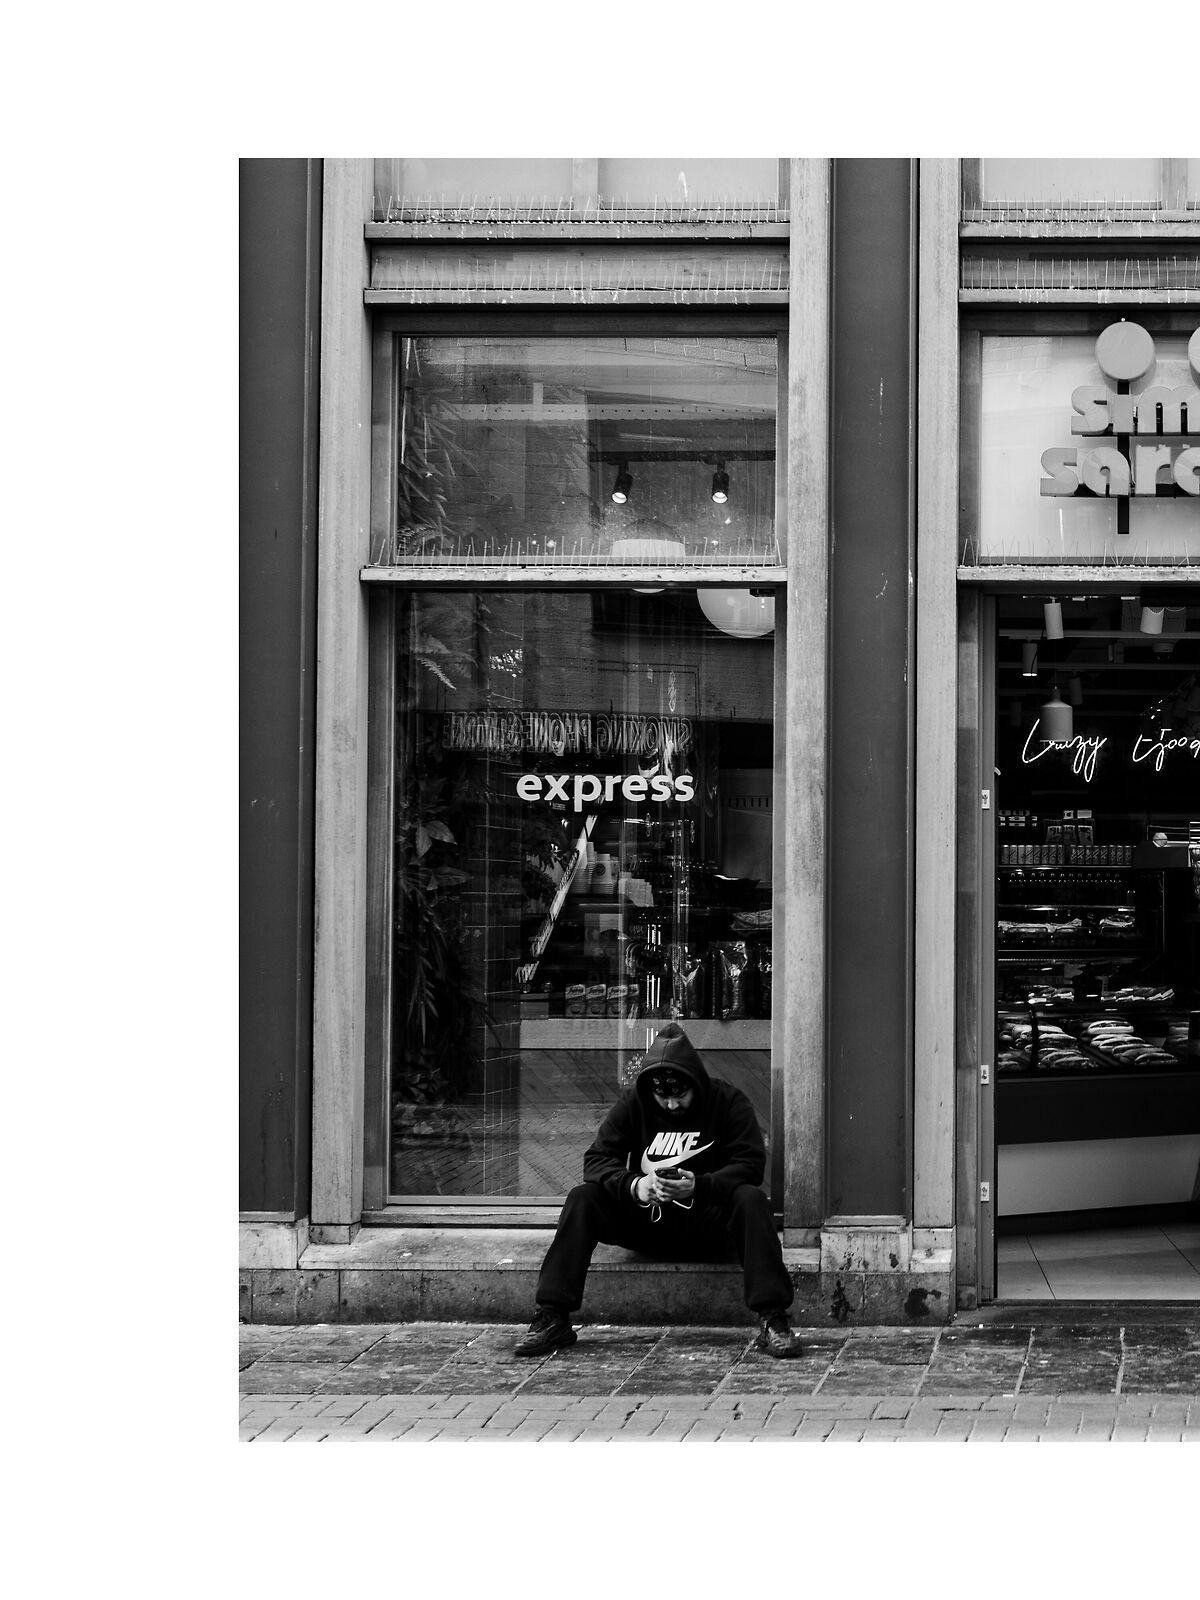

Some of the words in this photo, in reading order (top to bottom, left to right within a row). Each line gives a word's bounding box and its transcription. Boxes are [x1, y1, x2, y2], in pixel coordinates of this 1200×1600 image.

[1021, 718, 1108, 783] Czy
[516, 773, 696, 813] express
[647, 1131, 701, 1156] NIKE
